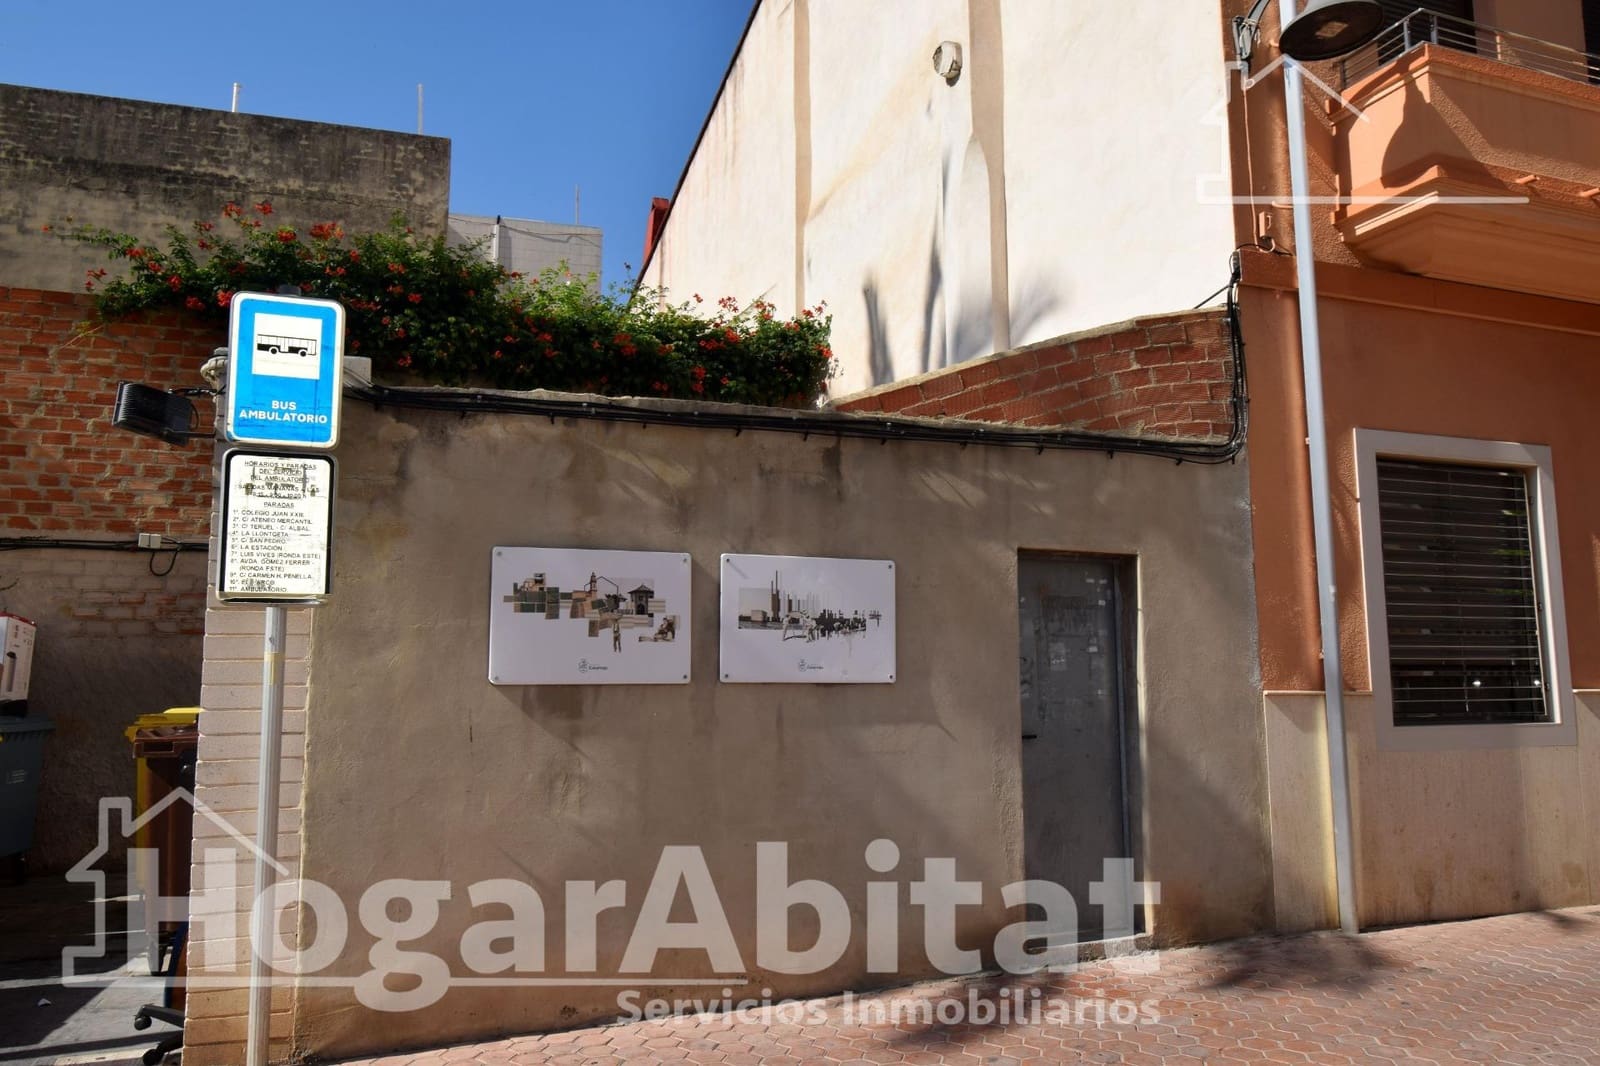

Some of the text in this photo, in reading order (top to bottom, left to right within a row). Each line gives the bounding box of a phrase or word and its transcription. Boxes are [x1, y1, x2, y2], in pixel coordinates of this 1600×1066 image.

[271, 400, 297, 411] BUS
[239, 409, 328, 424] AMBULATORIO
[245, 460, 279, 468] HORARIOS
[287, 463, 317, 471] PARADAS
